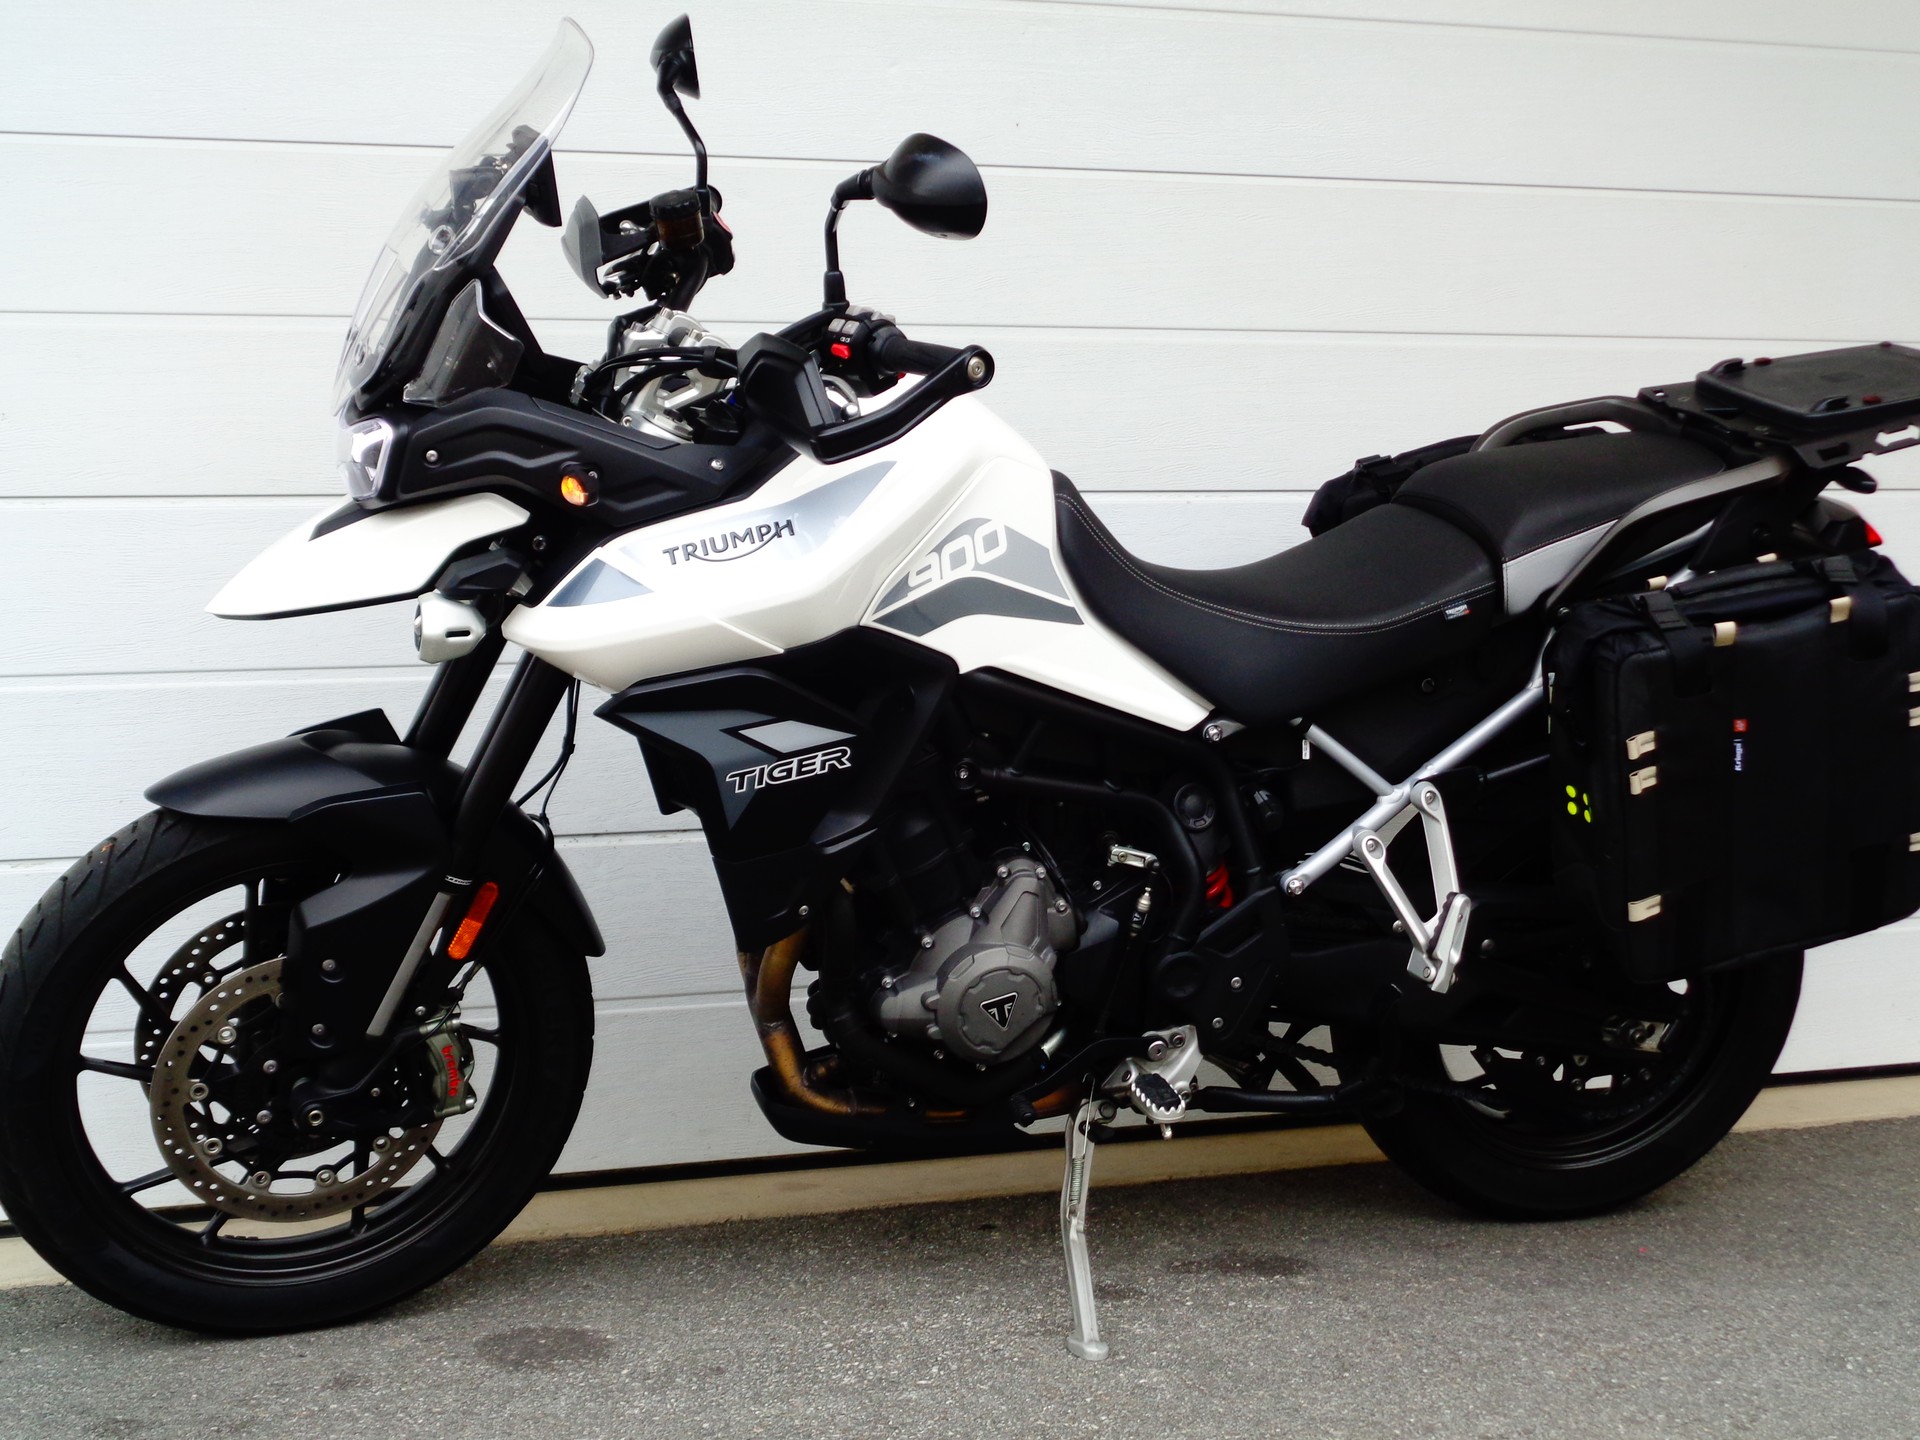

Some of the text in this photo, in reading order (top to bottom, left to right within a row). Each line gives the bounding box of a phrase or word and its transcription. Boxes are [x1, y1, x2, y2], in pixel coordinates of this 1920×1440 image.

[662, 519, 795, 565] TRIUMPH
[907, 519, 1008, 597] 900
[725, 746, 852, 793] TIGER
[441, 1045, 463, 1097] brembo
